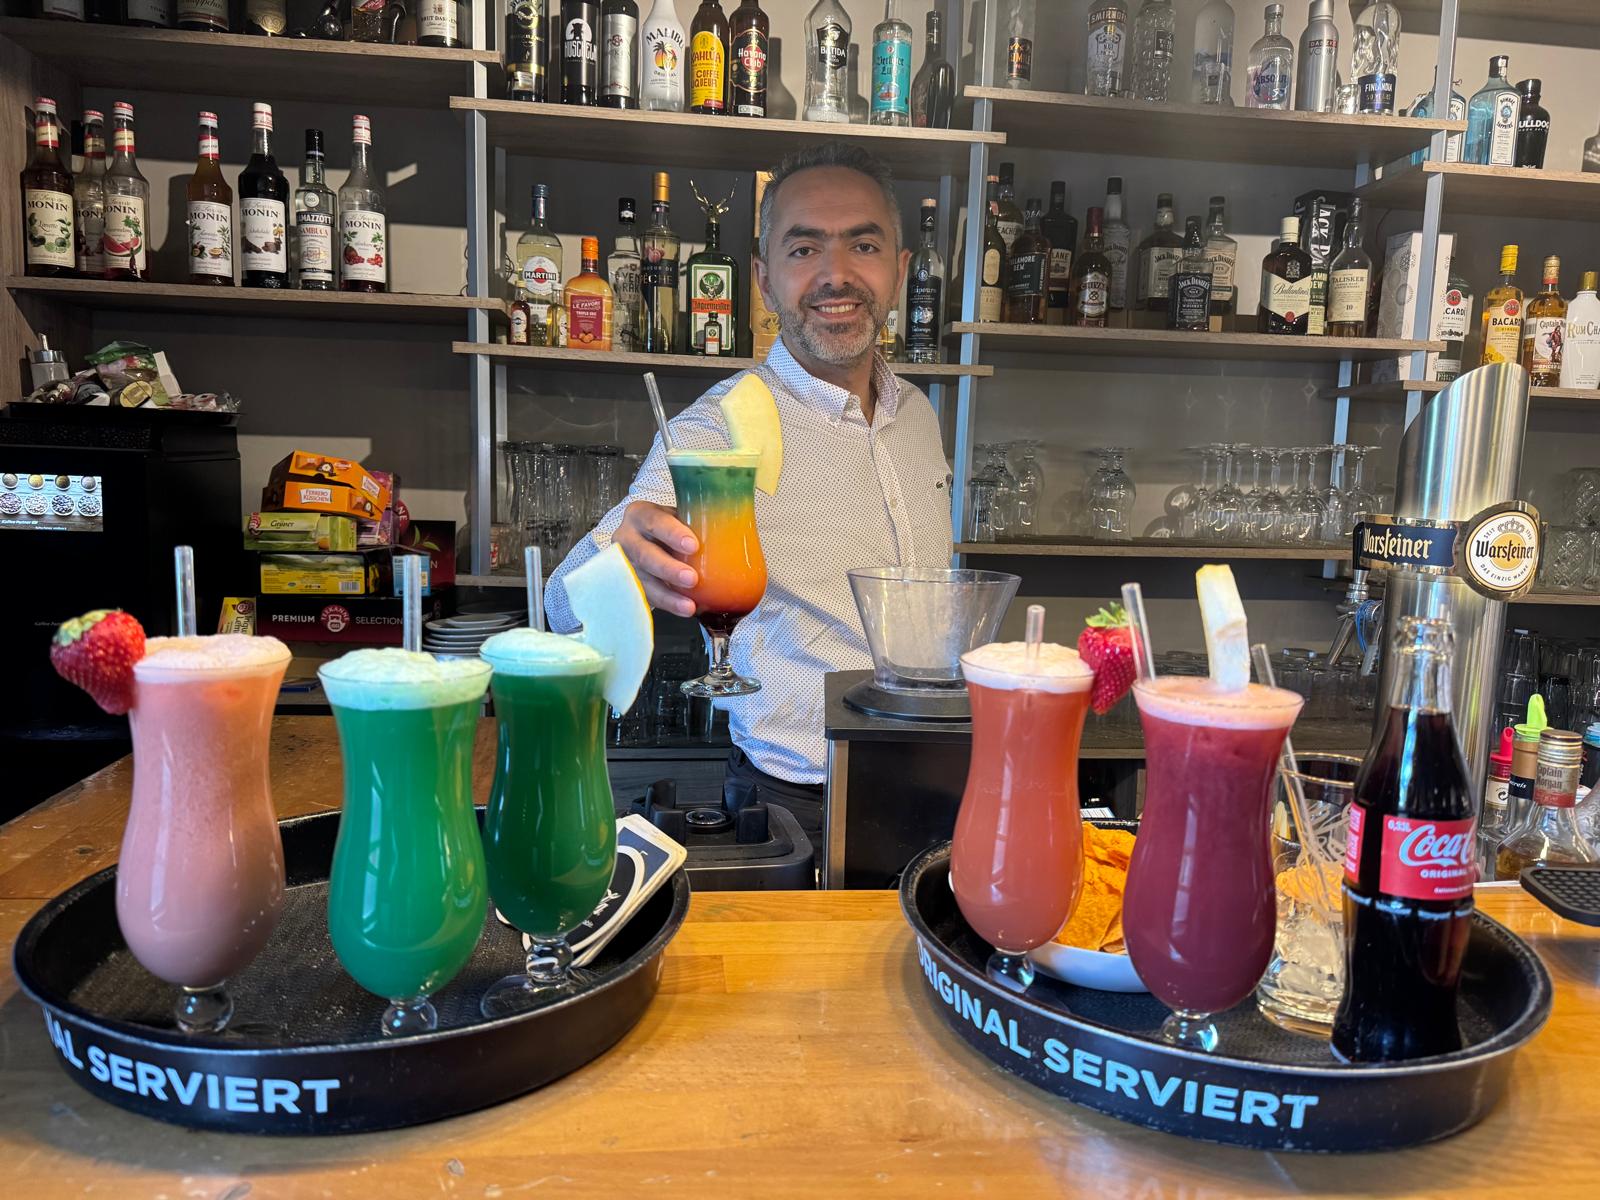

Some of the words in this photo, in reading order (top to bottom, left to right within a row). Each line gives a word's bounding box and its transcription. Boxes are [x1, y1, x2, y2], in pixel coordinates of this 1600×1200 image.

[738, 47, 767, 60] Havana
[744, 58, 762, 68] Club
[696, 69, 720, 80] COFFEE
[1256, 74, 1287, 85] ABSOUT
[1518, 120, 1550, 129] ULLDOG
[28, 200, 69, 213] MONIN
[190, 211, 229, 223] MONIN
[241, 207, 280, 219] MONIN
[299, 213, 333, 225] MAZZOTT
[345, 219, 382, 231] MONIN
[1051, 251, 1069, 260] LANE
[525, 271, 557, 281] MARTINI
[622, 271, 640, 283] YEN
[1331, 276, 1365, 284] TALISKER
[622, 282, 640, 294] RAK
[1443, 307, 1466, 317] CARDI
[1492, 317, 1521, 326] BACAR
[1540, 320, 1559, 329] Captain
[270, 519, 295, 529] Grüner
[1363, 527, 1433, 560] Warsteiner
[1475, 539, 1535, 562] Warsteiner
[1480, 563, 1490, 575] DAS
[1490, 573, 1512, 582] EINZIG
[320, 604, 351, 621] TEEKANNE
[272, 614, 316, 623] PREMIUM
[355, 616, 404, 625] SELECTION
[916, 935, 1032, 1059] ORIGINAL
[1042, 1037, 1320, 1130] SERVIERT
[87, 1045, 341, 1115] SERVIERT
